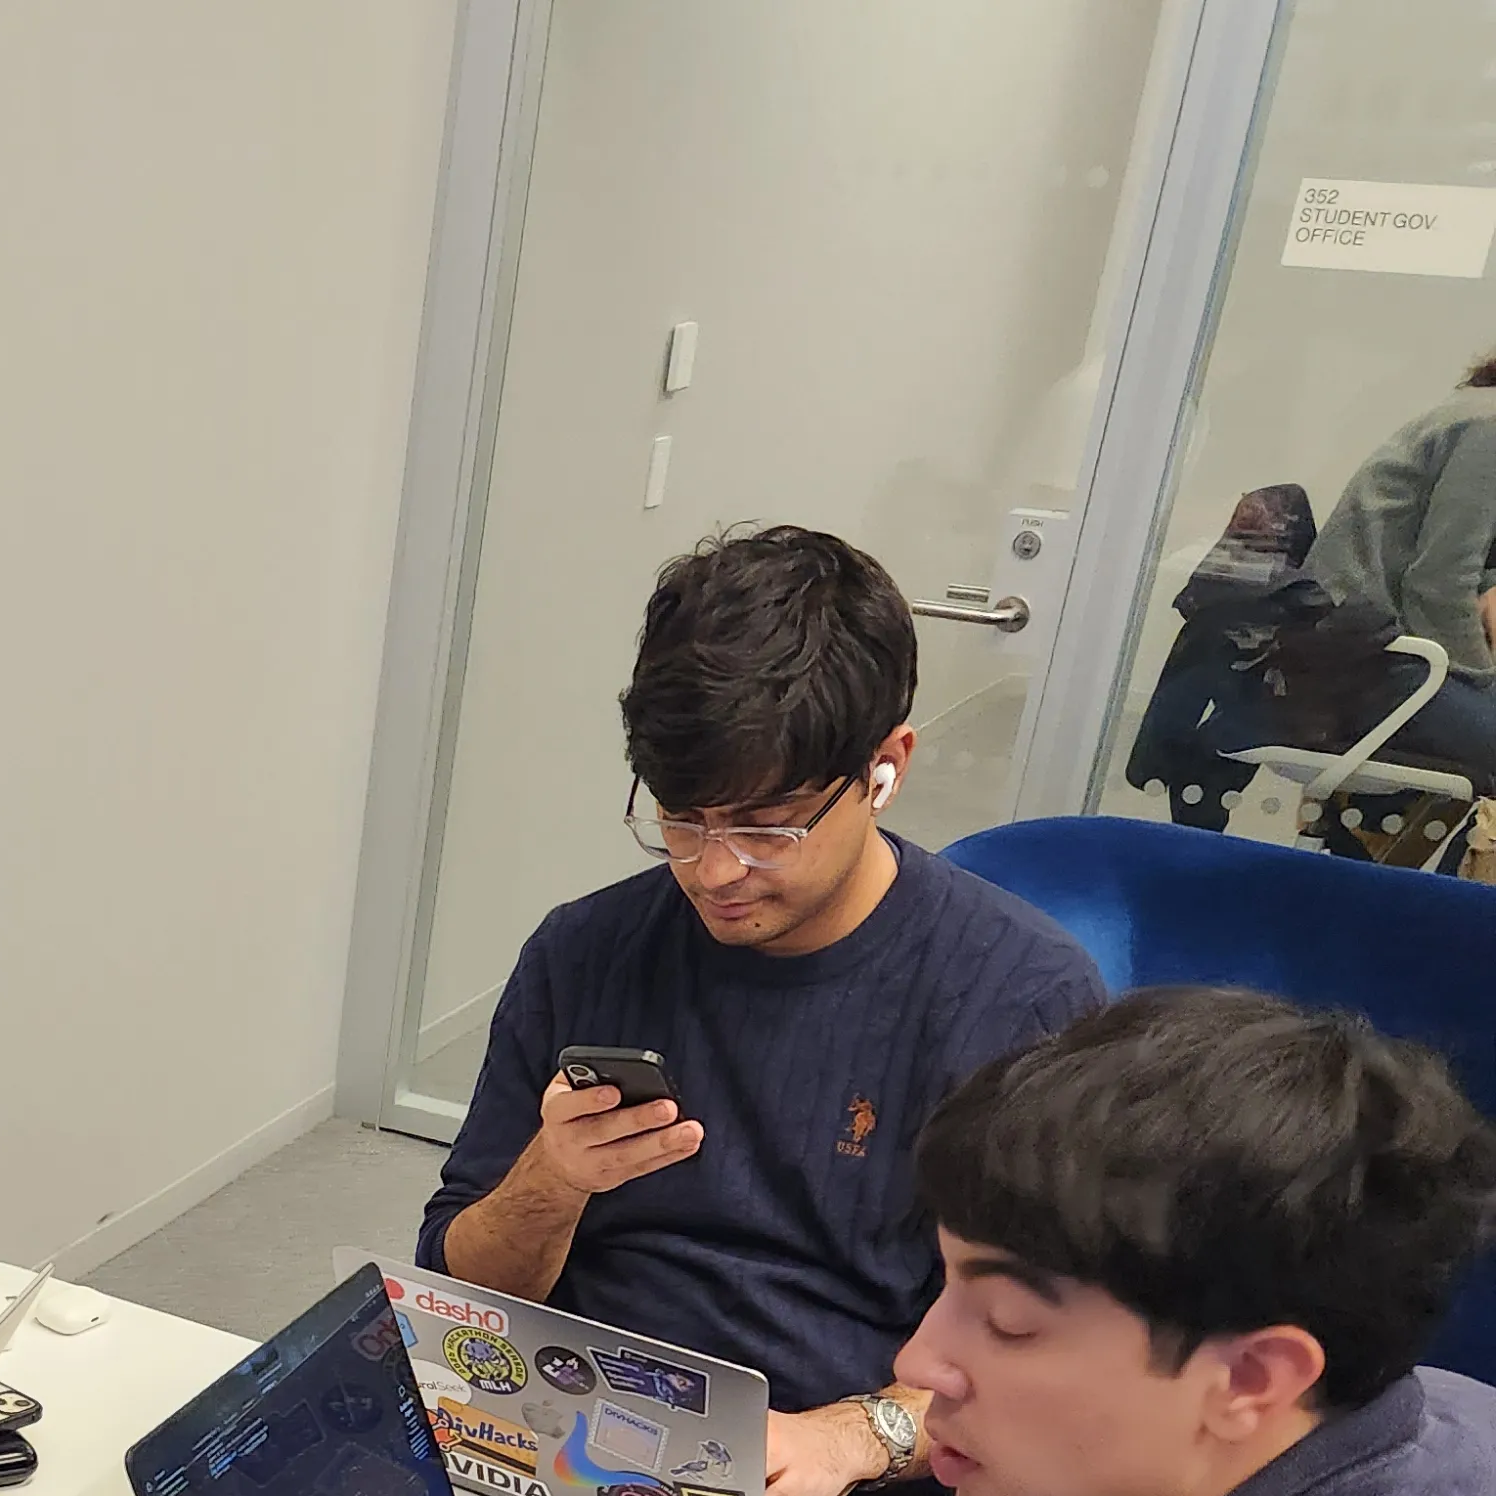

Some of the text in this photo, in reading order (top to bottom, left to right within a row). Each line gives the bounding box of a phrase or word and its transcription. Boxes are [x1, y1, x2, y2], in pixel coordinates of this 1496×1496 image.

[1303, 188, 1340, 205] 352
[1299, 207, 1439, 231] STUDENT GOV
[1295, 227, 1366, 247] OFFICE
[446, 1329, 498, 1350] HACKATHON
[499, 1342, 524, 1380] SEASON
[478, 1379, 512, 1392] MLH
